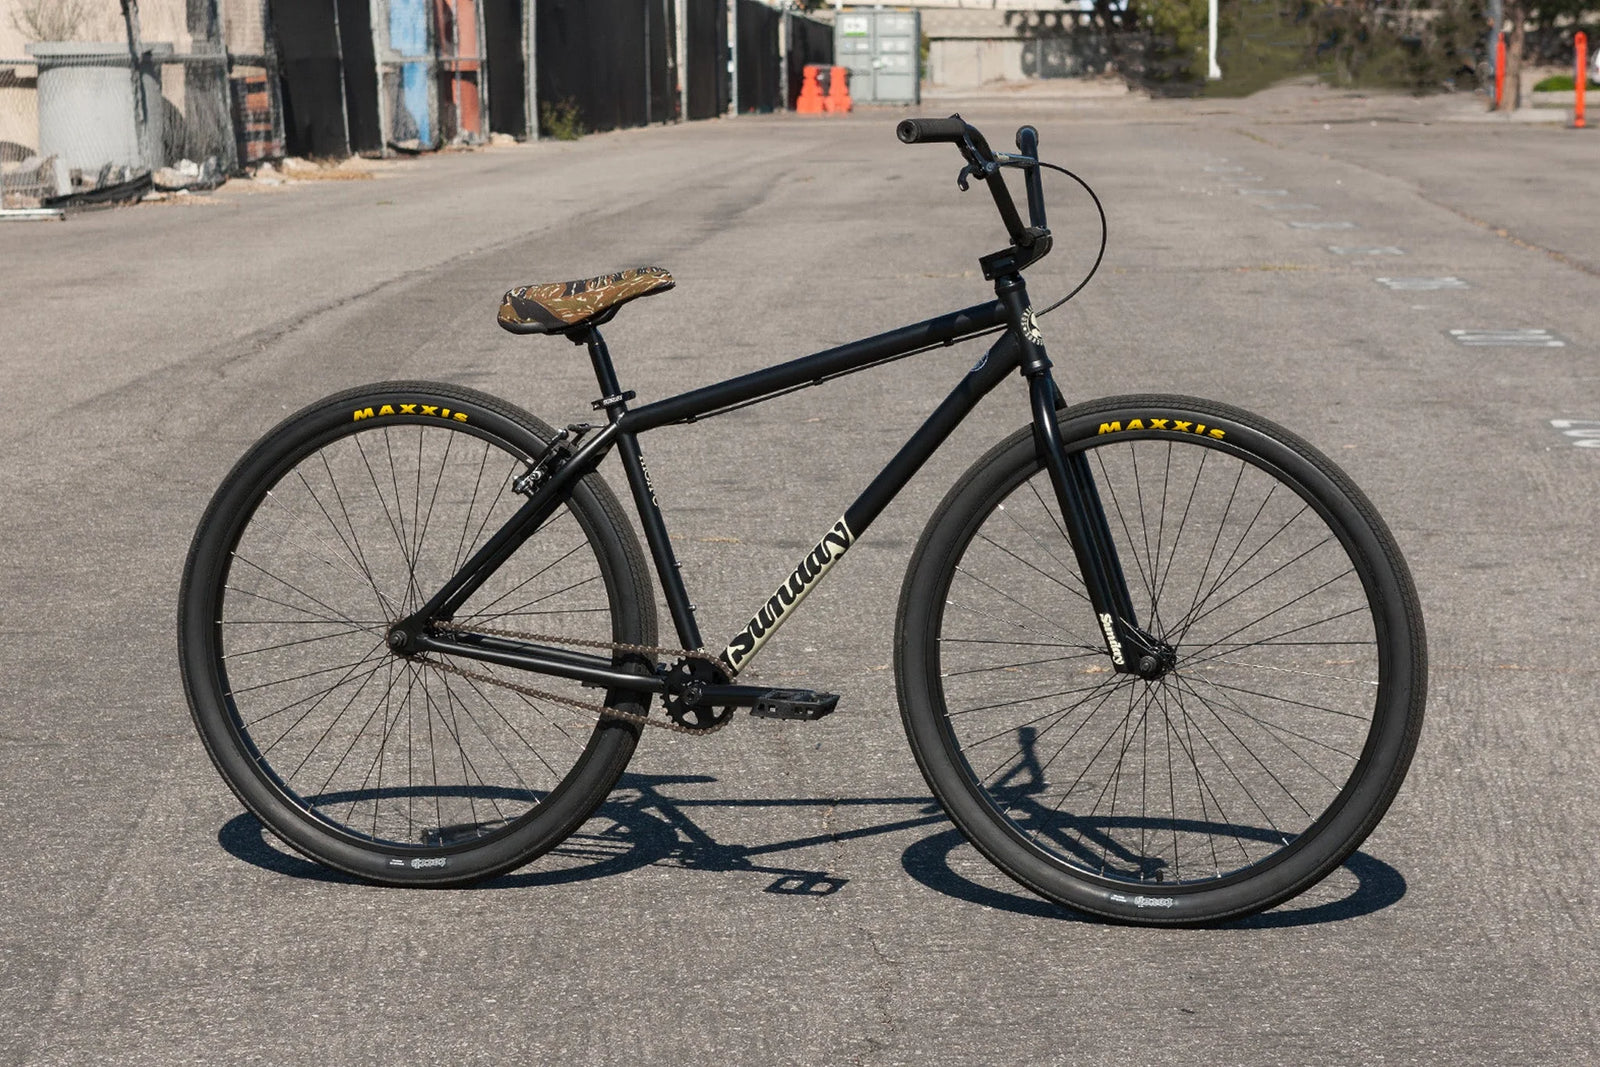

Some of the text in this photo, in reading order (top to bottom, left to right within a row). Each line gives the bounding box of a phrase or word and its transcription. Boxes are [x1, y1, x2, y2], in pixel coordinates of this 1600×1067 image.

[353, 404, 469, 422] MAXXIS
[1098, 418, 1226, 439] MAXXIS
[1099, 613, 1125, 665] Sunday
